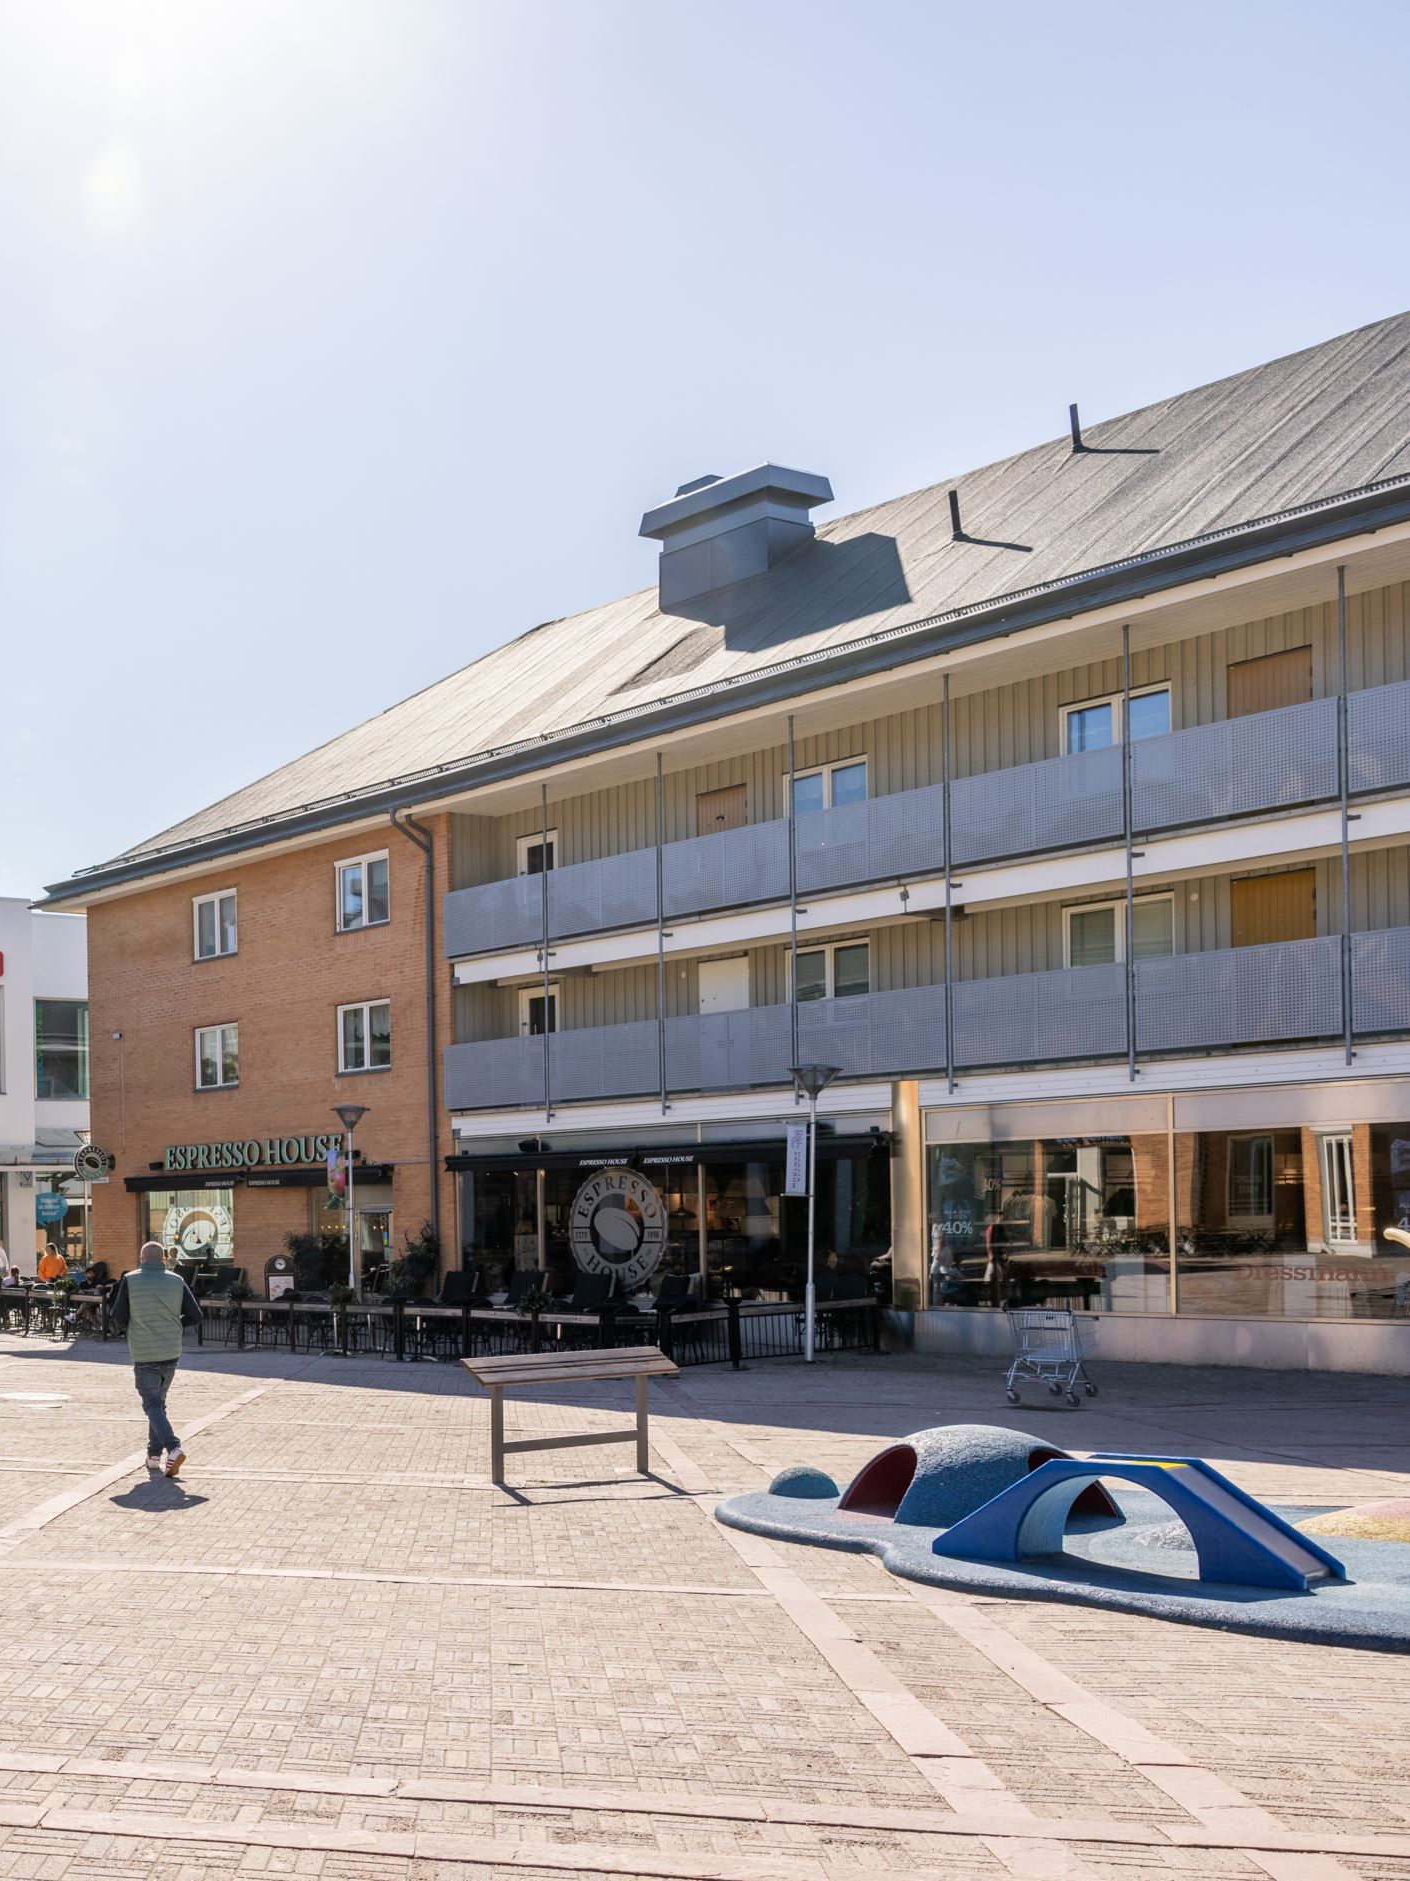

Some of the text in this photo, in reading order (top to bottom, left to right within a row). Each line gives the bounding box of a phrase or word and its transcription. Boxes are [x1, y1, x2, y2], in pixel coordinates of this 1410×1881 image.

[79, 1147, 106, 1160] ESPRESSO
[164, 1134, 342, 1170] ESPRESSO HOUSE
[643, 1156, 672, 1164] ESPRESSO
[578, 1175, 657, 1218] ESPRESSO
[942, 1221, 973, 1234] 40%
[587, 1255, 649, 1280] HOUSE
